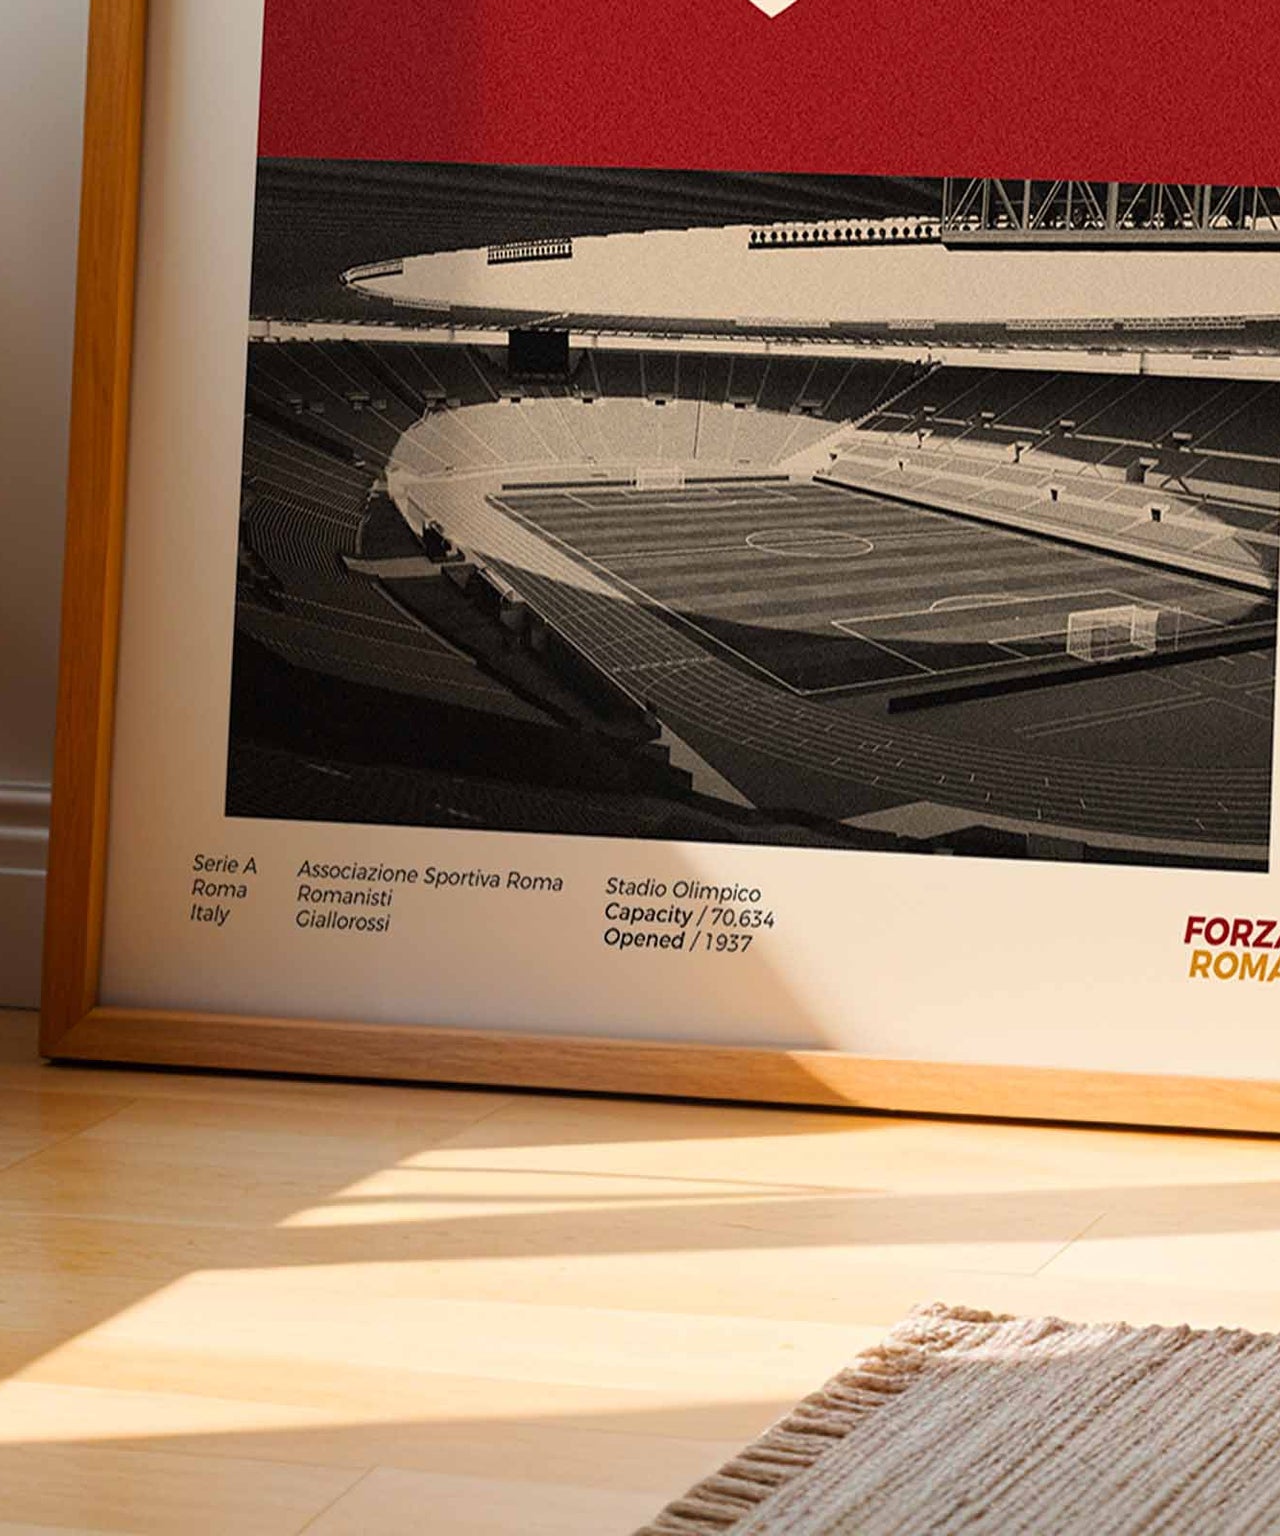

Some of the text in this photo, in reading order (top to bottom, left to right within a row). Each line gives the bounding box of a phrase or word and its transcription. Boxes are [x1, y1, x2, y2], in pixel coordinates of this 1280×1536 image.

[192, 854, 257, 875] Serie A
[297, 860, 563, 892] Associazione Sportiva Roma
[192, 879, 247, 898] Roma
[297, 885, 392, 907] Romanisti
[606, 877, 761, 904] Stadio Olimpico
[190, 904, 230, 927] Italy
[296, 910, 390, 932] Giallorossi
[605, 902, 776, 929] Capacity / 70.634
[604, 928, 752, 952] Opened / 1937
